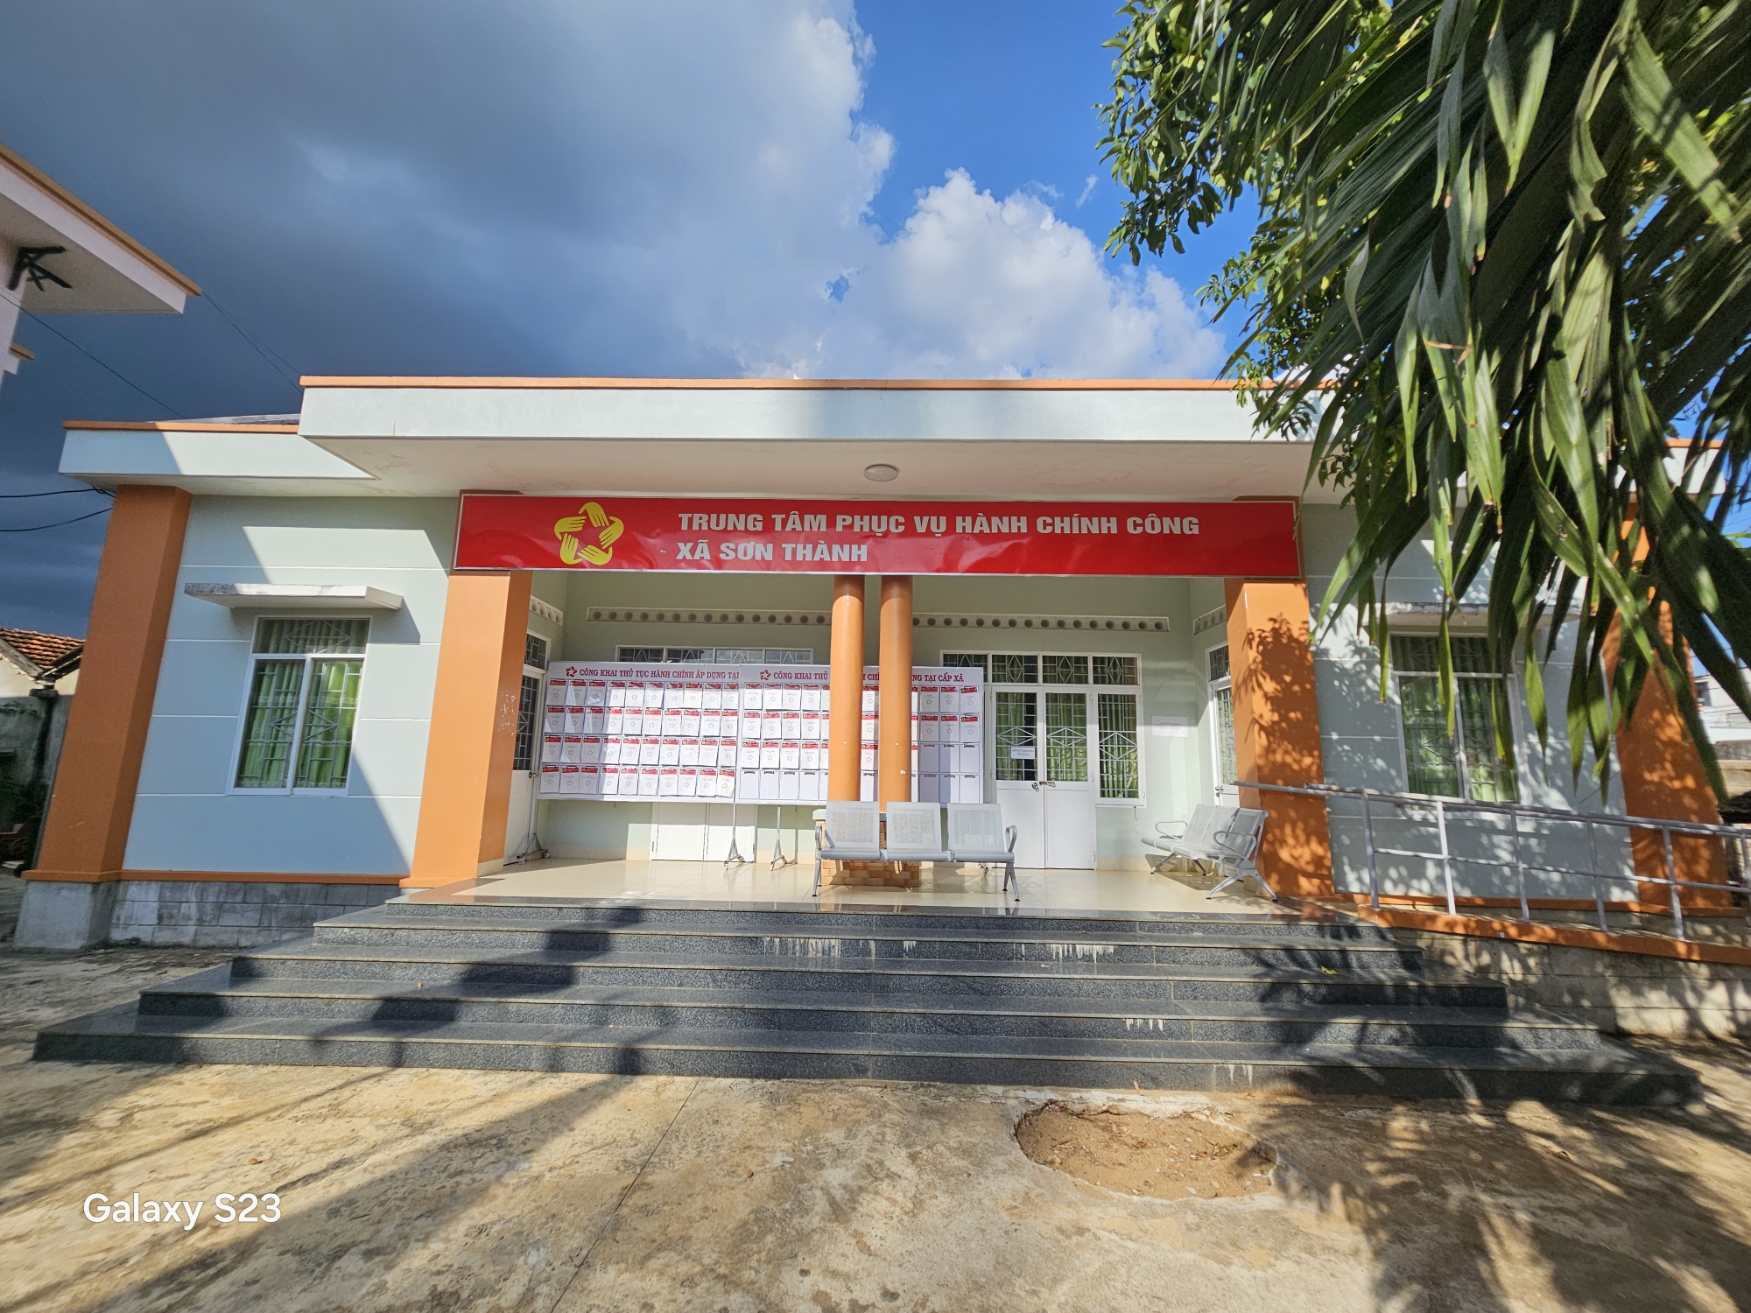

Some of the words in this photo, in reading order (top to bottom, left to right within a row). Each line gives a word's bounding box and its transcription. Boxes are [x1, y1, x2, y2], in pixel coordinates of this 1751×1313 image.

[678, 513, 763, 531] TRUNG
[771, 510, 827, 532] TÂM
[835, 514, 905, 537] PHỤC
[914, 515, 946, 537] VỤ
[955, 511, 1028, 534] HÀNH
[1036, 512, 1118, 535] CHÍNH
[1126, 512, 1199, 535] CÔNG
[676, 539, 711, 560] XÃ
[719, 541, 773, 560] SƠN
[781, 540, 868, 561] THÀNH
[579, 667, 599, 676] CÔNG
[600, 669, 617, 677] KHAI
[619, 667, 633, 677] THỦ
[635, 670, 650, 679] TỤC
[650, 669, 671, 678] HÀNH
[672, 669, 694, 679] CHÍNH
[695, 668, 705, 679] ÁP
[706, 671, 726, 681] DỤNG
[727, 671, 739, 681] TẠI
[773, 670, 793, 680] CÔNG
[794, 671, 812, 680] KHAI
[813, 669, 828, 680] THỦ
[924, 674, 936, 683] TẠI
[938, 672, 952, 682] CẤP
[953, 674, 964, 682] XÃ
